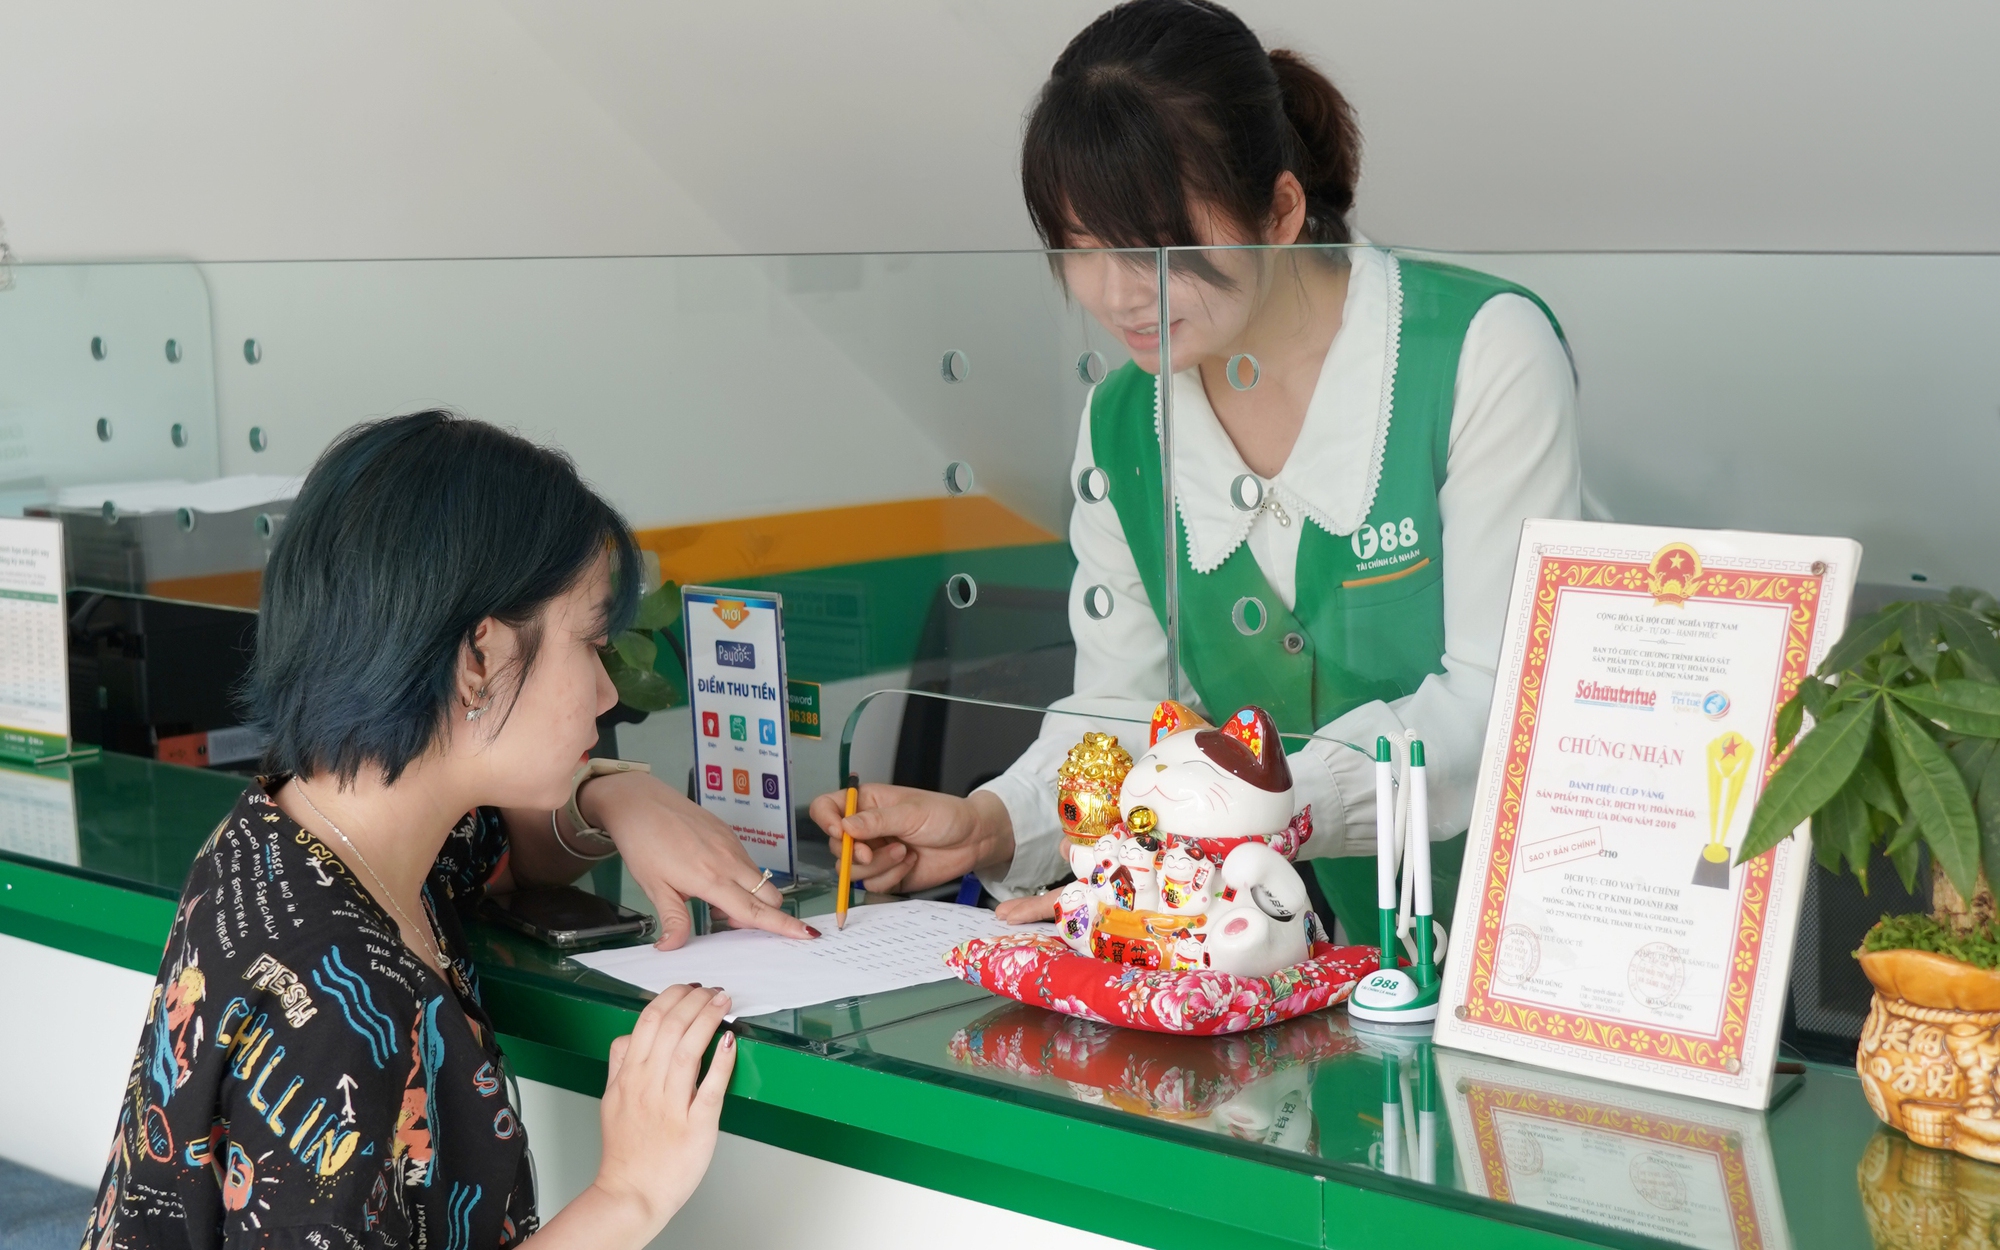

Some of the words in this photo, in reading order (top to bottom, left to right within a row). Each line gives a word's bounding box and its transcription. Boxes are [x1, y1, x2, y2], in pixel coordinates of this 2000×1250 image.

[1351, 516, 1419, 560] F88
[1356, 562, 1367, 572] TÀI
[1368, 558, 1388, 570] CHÍNH
[1389, 554, 1398, 565] CÁ
[1398, 549, 1420, 563] NHÂN
[722, 608, 742, 621] MỚI
[1595, 611, 1617, 621] CỘNG
[1634, 614, 1644, 622] XÃ
[1645, 615, 1659, 625] HỘI
[1659, 617, 1676, 625] CHỦ
[1677, 618, 1701, 627] NGHĨA
[1702, 620, 1720, 630] VIỆT
[1720, 622, 1738, 630] NAM
[719, 645, 744, 665] Payoo
[698, 675, 725, 695] ĐIỂM
[727, 682, 749, 697] THU
[1558, 734, 1626, 759] CHỨNG
[1629, 744, 1684, 768] NHẬN
[1535, 788, 1552, 799] SẢN
[1580, 795, 1594, 804] TIN
[1594, 796, 1612, 808] CẬY,
[1613, 799, 1636, 810] DỊCH
[1636, 802, 1648, 813] VỤ
[1649, 804, 1674, 815] HOÀN
[1568, 779, 1594, 791] DANH
[1595, 783, 1617, 794] HIỆU
[1619, 785, 1639, 796] CÚP
[1640, 788, 1664, 800] VÀNG
[1574, 808, 1595, 819] HIỆU
[1596, 811, 1608, 820] ƯA
[1609, 812, 1633, 824] DÙNG
[1634, 816, 1653, 826] NĂM
[1654, 819, 1676, 829] 2016
[1528, 852, 1545, 863] SAO
[1546, 850, 1551, 858] Y
[1553, 844, 1570, 856] BẢN
[1571, 838, 1597, 852] CHÍNH
[268, 832, 285, 875] PLEASED
[280, 881, 293, 899] AND
[239, 818, 260, 850] GOOD
[255, 880, 280, 940] ESPECIALLY
[1563, 872, 1584, 882] DỊCH
[1584, 875, 1598, 886] VỤ:
[1599, 877, 1618, 887] CHO
[1619, 880, 1637, 890] VAY
[1636, 882, 1651, 892] TÀI
[1651, 885, 1680, 897] CHÍNH
[231, 876, 249, 938] SOMETHING
[1560, 884, 1584, 897] CÔNG
[1586, 889, 1596, 898] TY
[1597, 892, 1610, 900] CP
[1609, 893, 1632, 904] KINH
[1632, 897, 1663, 908] DOANH
[332, 909, 359, 919] WHEN
[216, 909, 236, 959] HAPPENED
[358, 925, 397, 947] STAYING
[366, 943, 391, 957] PLACE
[370, 959, 415, 997] ENJOYMENT
[1370, 976, 1399, 990] F88
[416, 1203, 428, 1250] NJOYMENT
